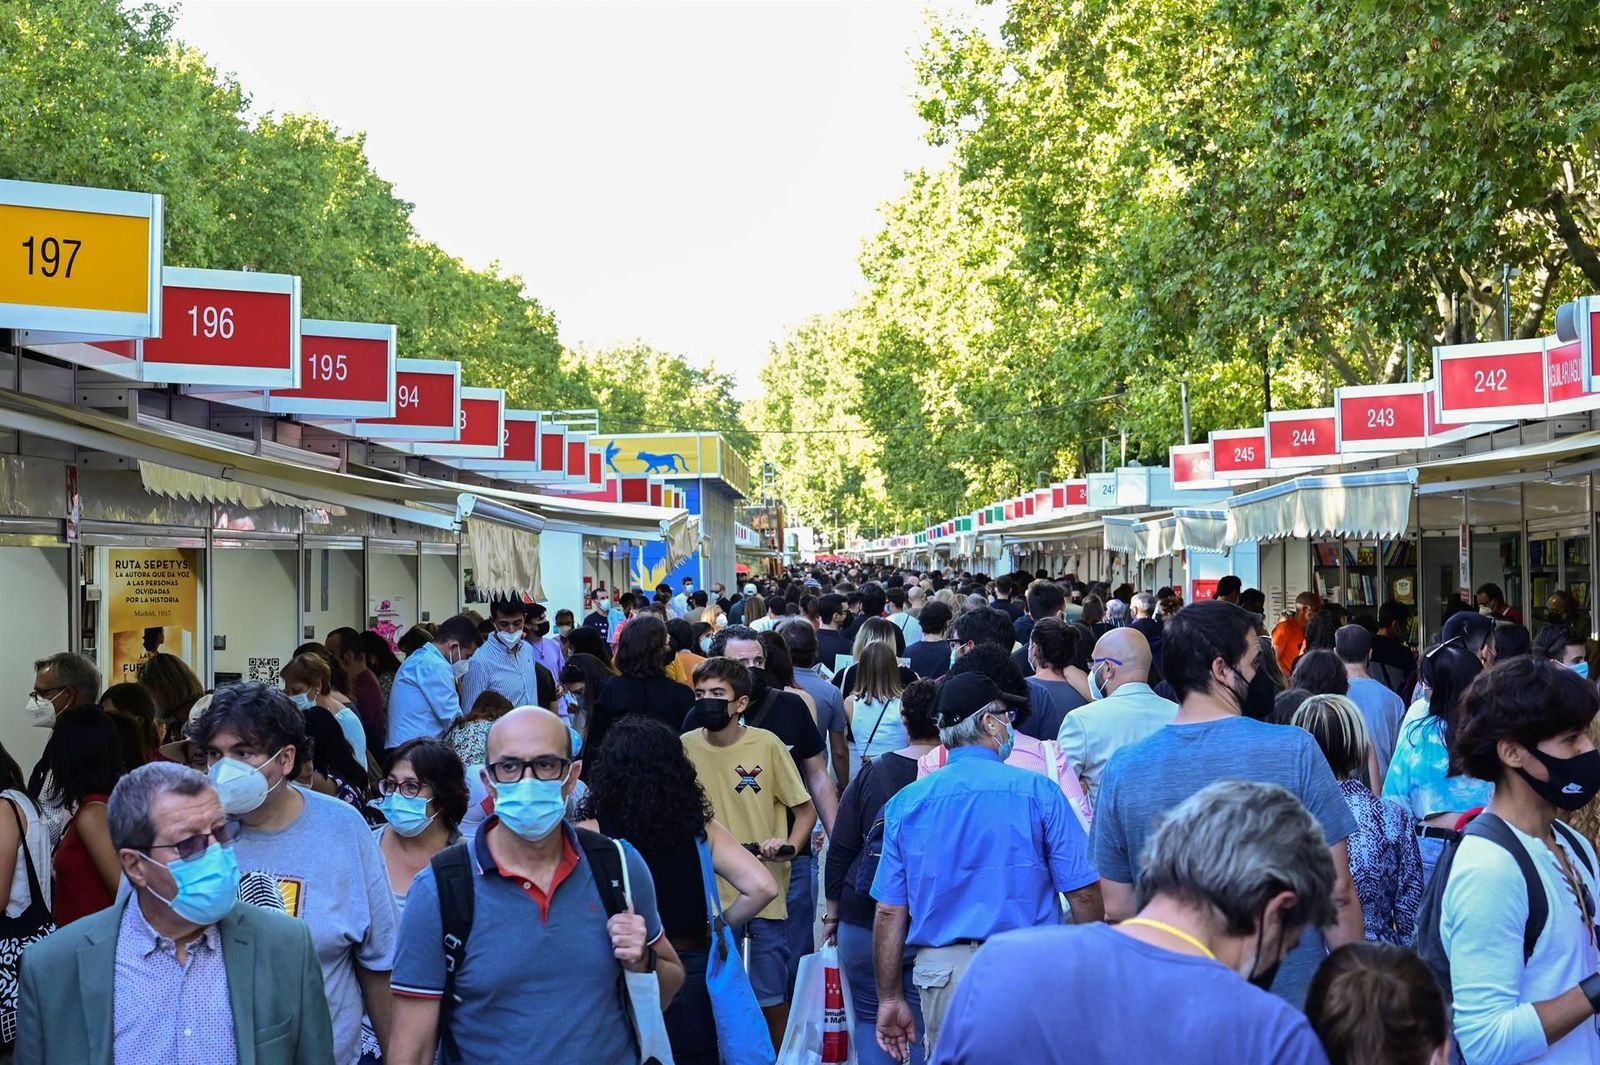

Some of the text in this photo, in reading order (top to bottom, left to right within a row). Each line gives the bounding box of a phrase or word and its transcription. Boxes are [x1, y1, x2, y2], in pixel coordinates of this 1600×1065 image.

[21, 235, 82, 279] 197
[187, 305, 235, 339] 196
[308, 353, 348, 381] 195
[1474, 368, 1508, 392] 242
[398, 385, 420, 408] 94
[1367, 408, 1395, 428] 243
[1292, 429, 1316, 447] 244
[1233, 447, 1255, 462] 245
[1102, 484, 1116, 495] 247
[115, 560, 141, 569] RUTA
